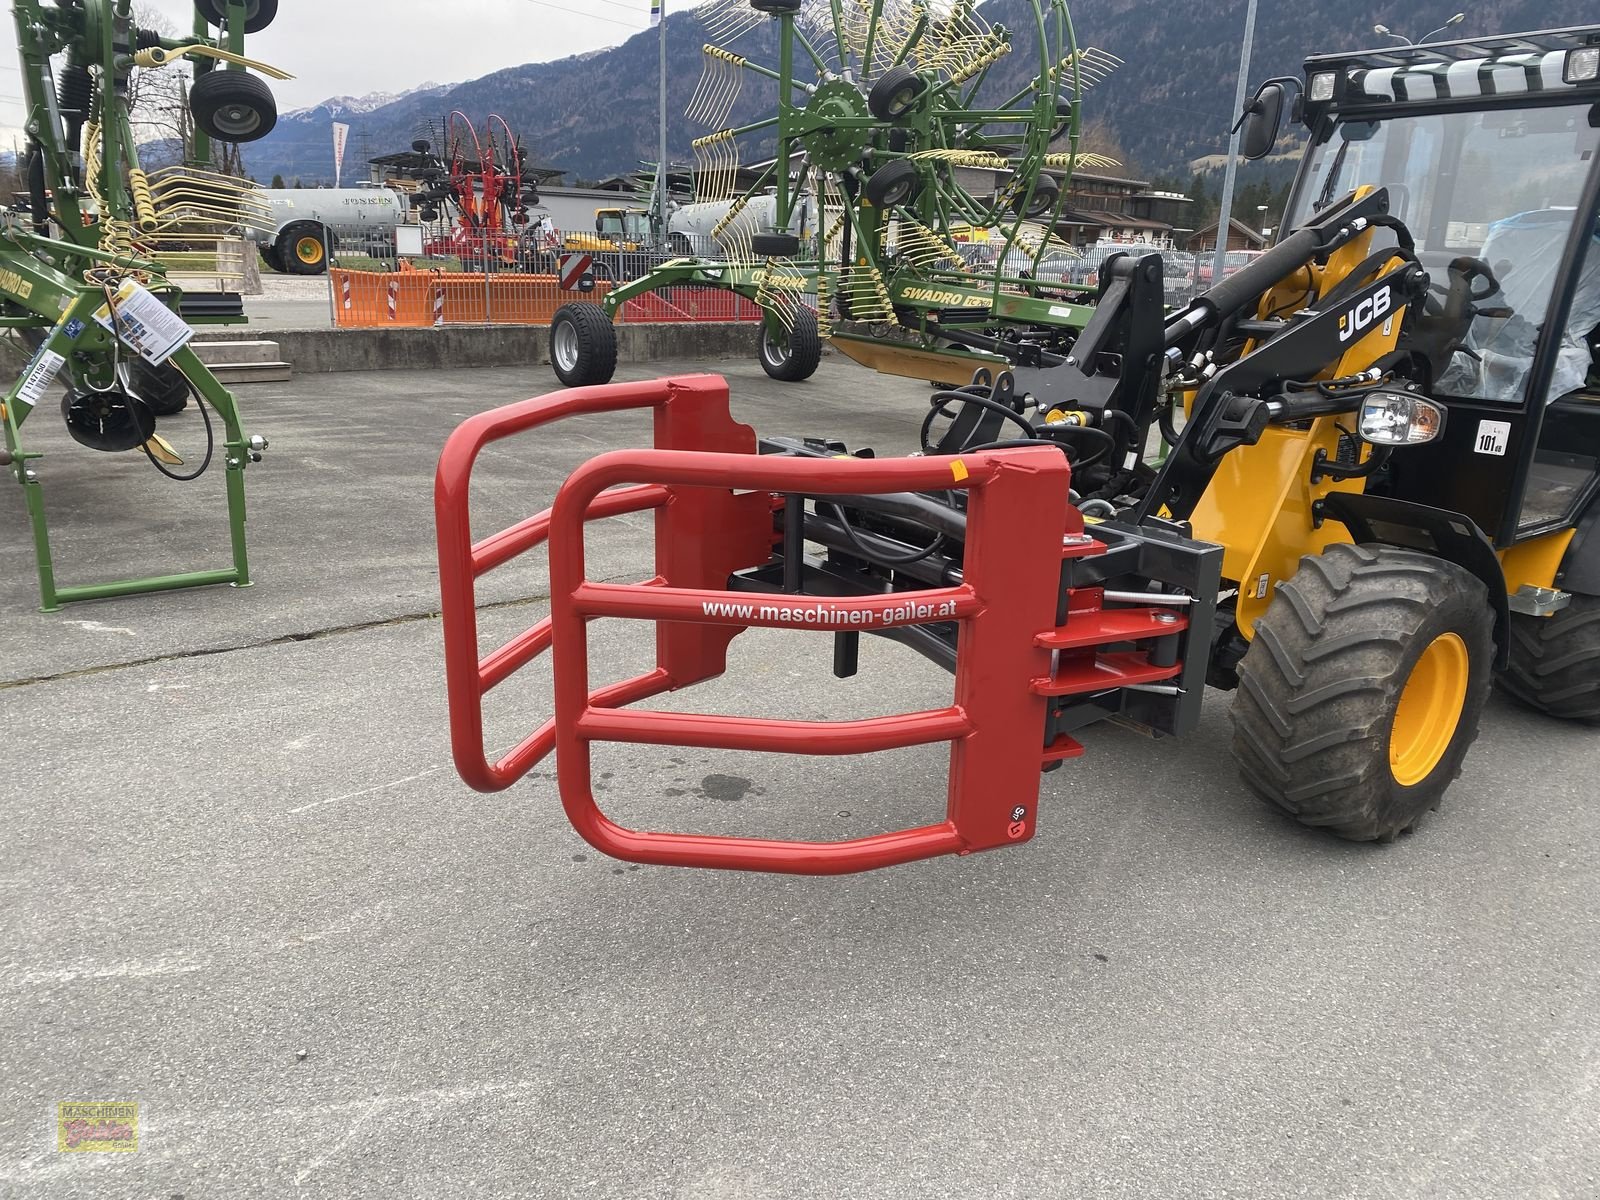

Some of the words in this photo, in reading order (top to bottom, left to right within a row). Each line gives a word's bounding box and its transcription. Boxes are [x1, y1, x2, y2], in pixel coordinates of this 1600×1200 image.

[900, 286, 963, 305] SWADRO
[1339, 285, 1391, 342] JCB
[25, 363, 46, 390] 1147150
[1480, 434, 1496, 452] 101
[702, 599, 957, 625] www.maschinen-gailer.at
